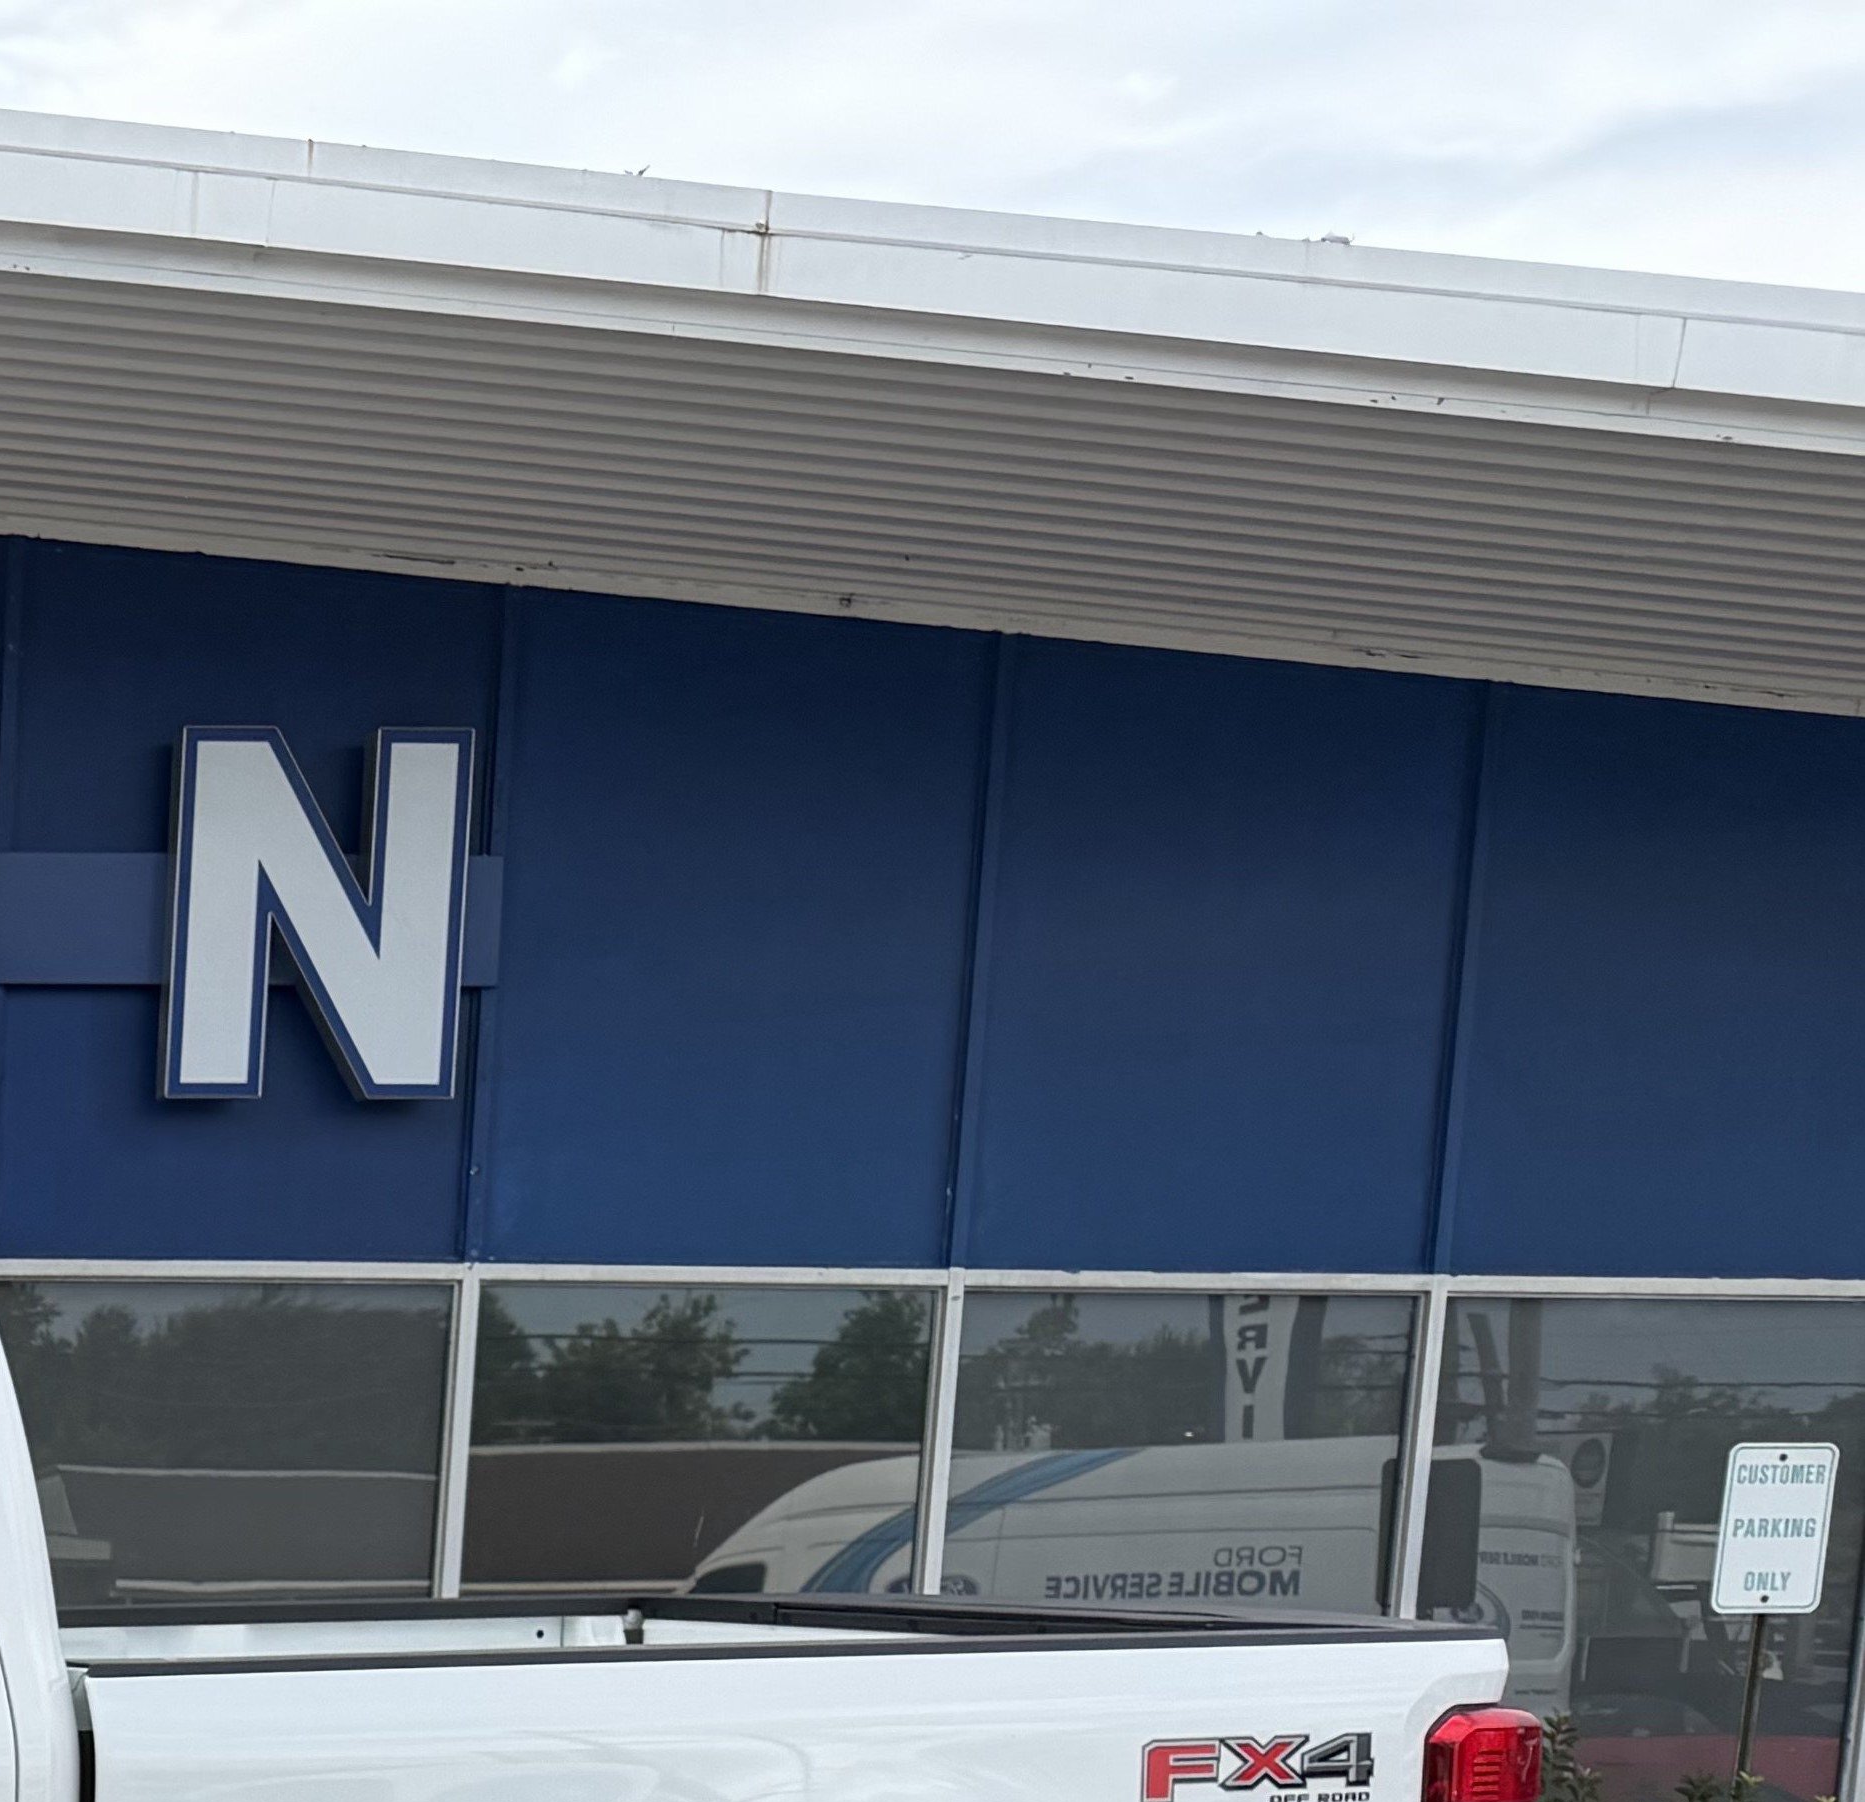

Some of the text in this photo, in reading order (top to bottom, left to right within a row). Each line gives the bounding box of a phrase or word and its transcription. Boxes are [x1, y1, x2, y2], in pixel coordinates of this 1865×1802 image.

[1737, 1464, 1826, 1484] CUSTOMER
[1732, 1518, 1817, 1538] PARKING
[1743, 1571, 1792, 1592] ONLY
